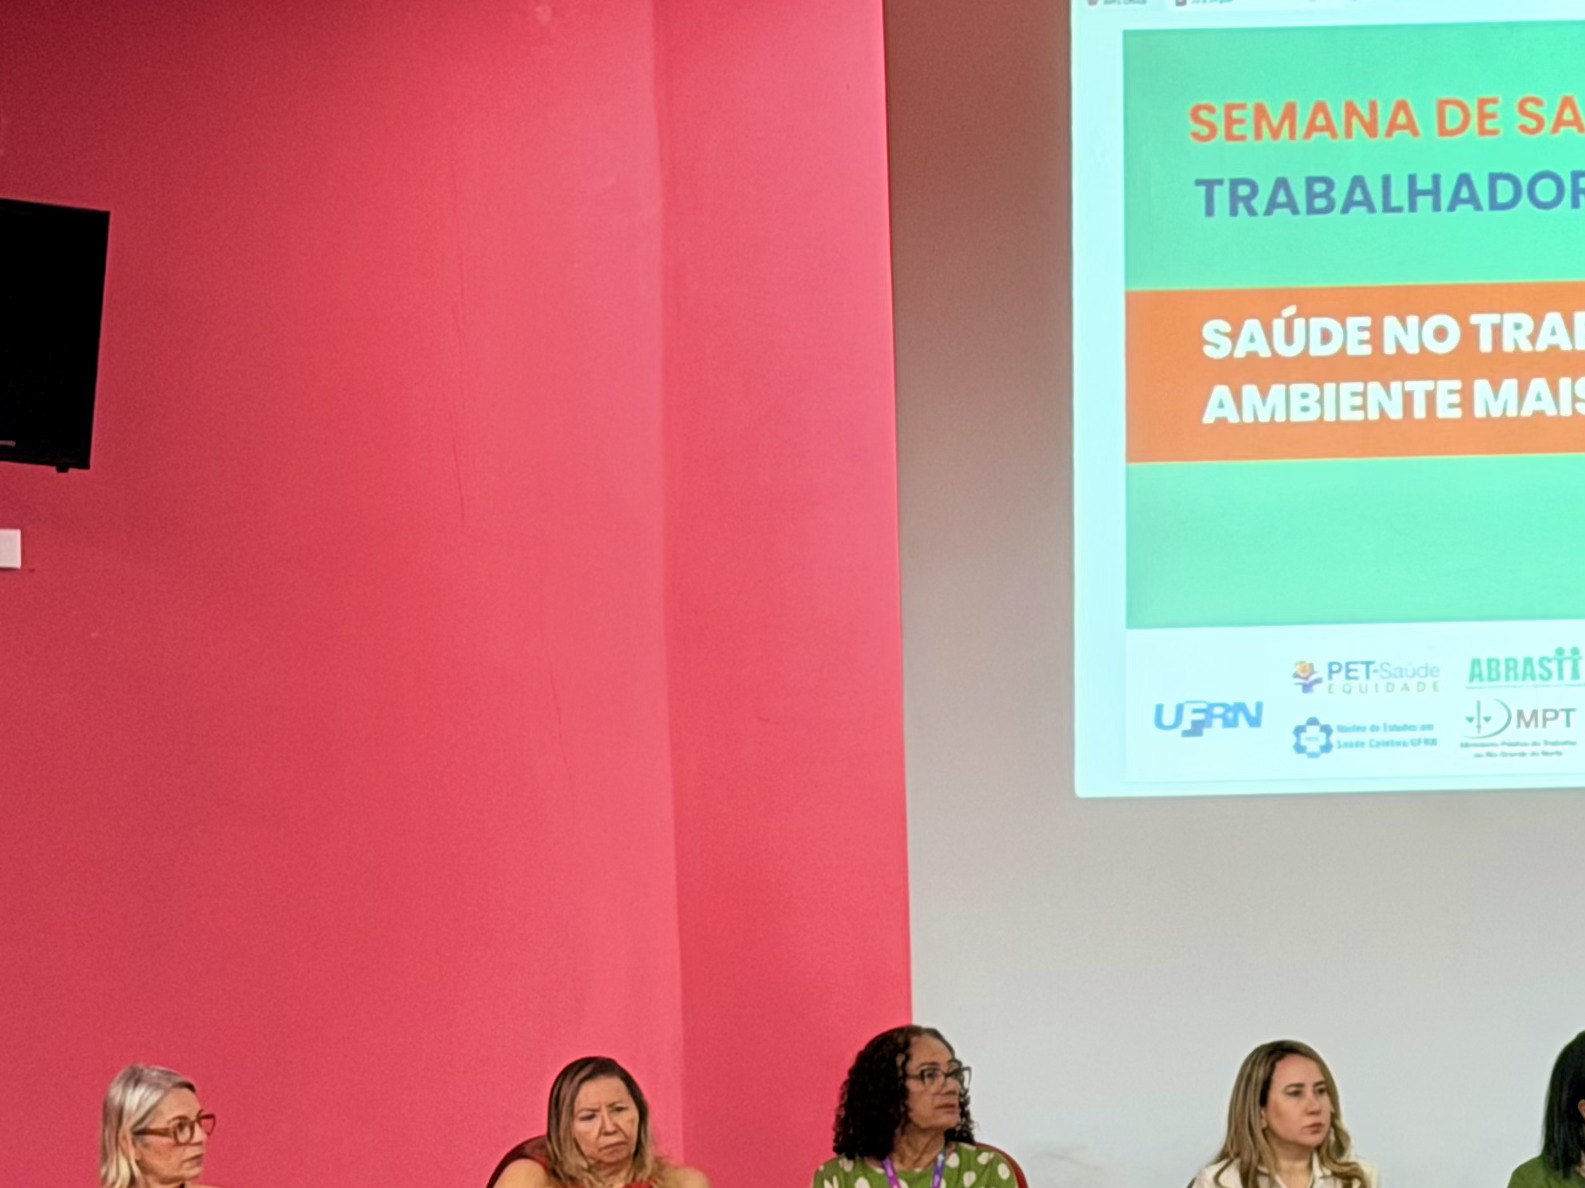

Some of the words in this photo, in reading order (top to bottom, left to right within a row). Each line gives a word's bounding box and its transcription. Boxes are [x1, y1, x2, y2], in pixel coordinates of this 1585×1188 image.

[1189, 99, 1421, 144] SEMANA
[1436, 96, 1501, 139] DE
[1202, 305, 1372, 359] SAÚDE
[1383, 314, 1461, 355] NO
[1202, 379, 1462, 424] AMBIENTE
[1327, 682, 1440, 695] EQUIDADE
[1154, 700, 1263, 737] UFRN
[1517, 708, 1576, 728] MPT
